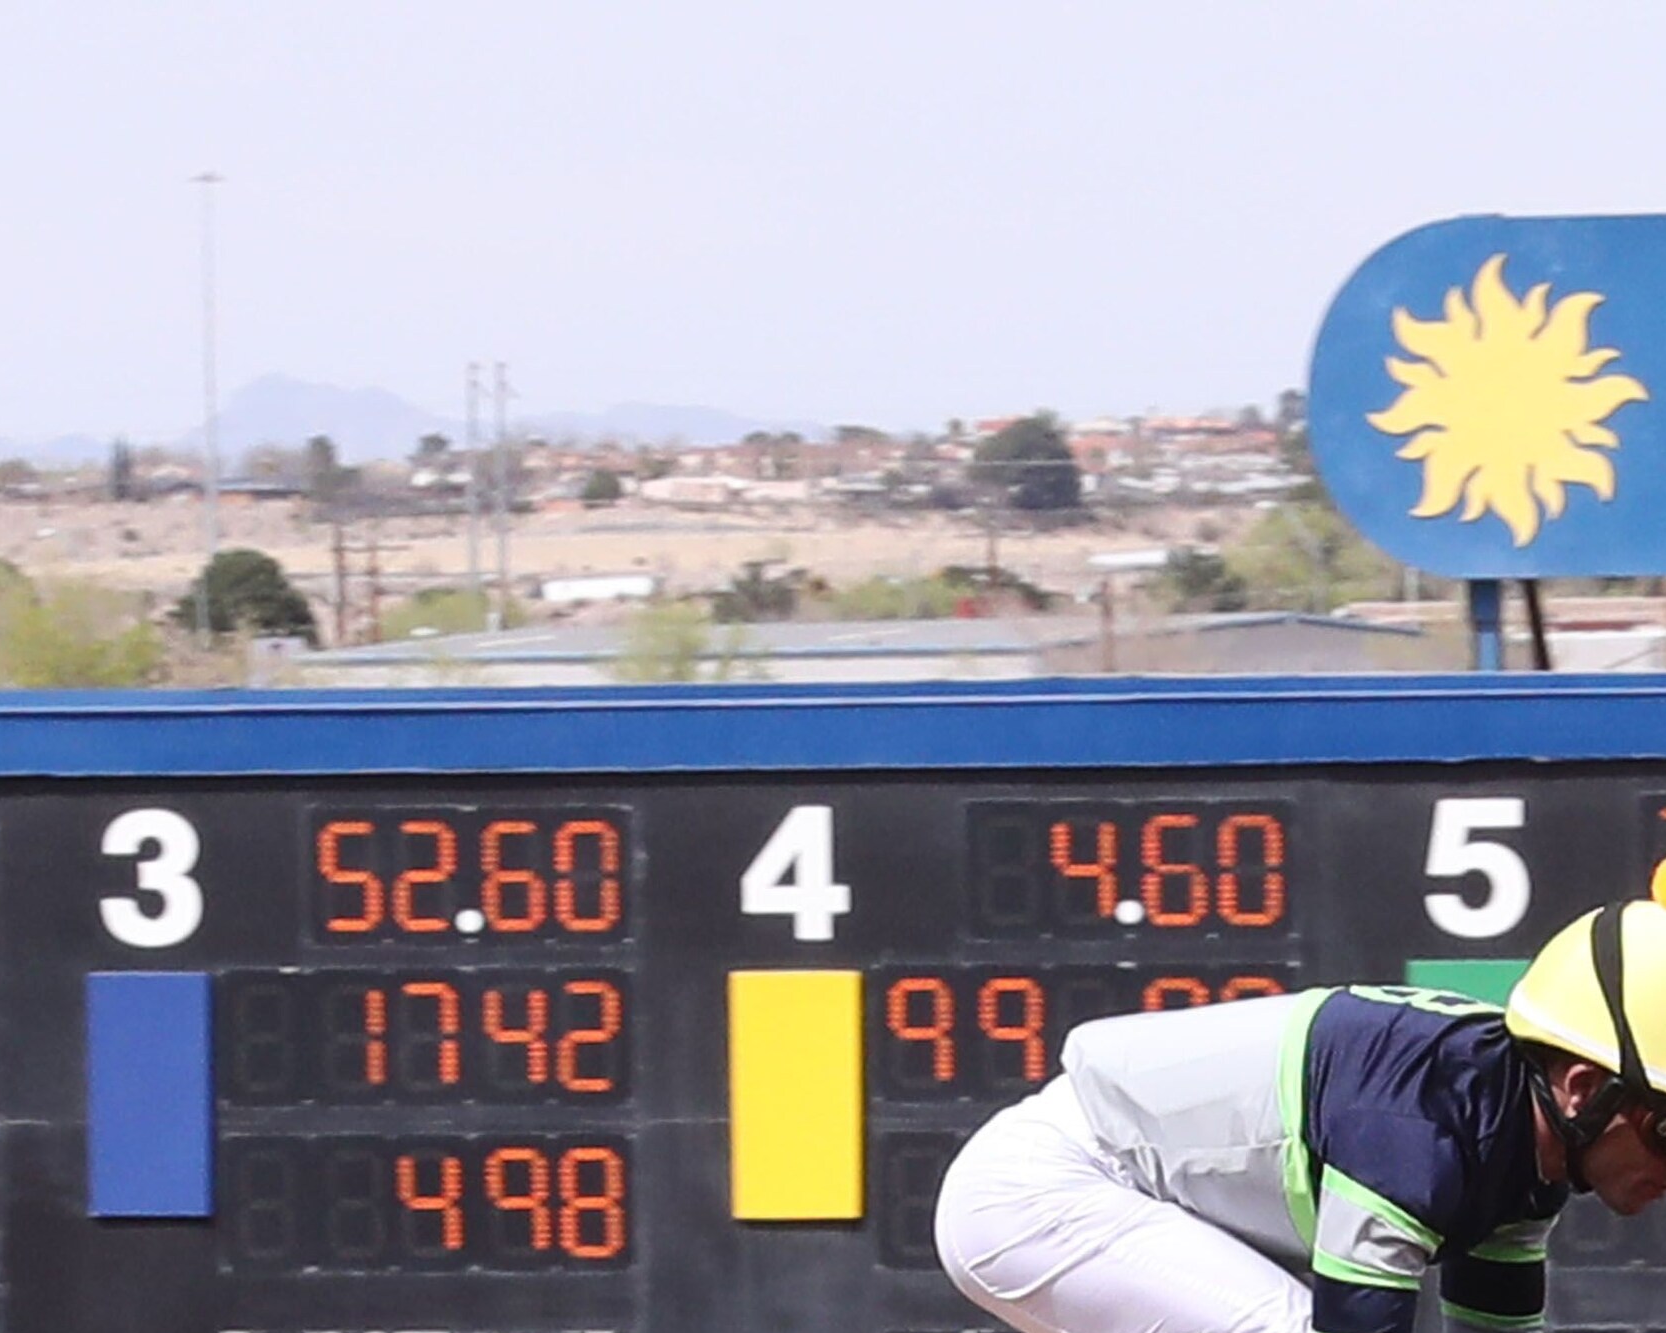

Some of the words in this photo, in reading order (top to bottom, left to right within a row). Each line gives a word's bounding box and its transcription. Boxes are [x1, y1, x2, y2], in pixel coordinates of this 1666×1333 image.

[99, 808, 204, 948] 3
[317, 820, 621, 933] 52.60
[740, 805, 851, 942] 4
[1050, 813, 1284, 927] 4.60
[1424, 797, 1531, 938] 5
[364, 980, 622, 1092] 1742
[396, 1147, 625, 1259] 498
